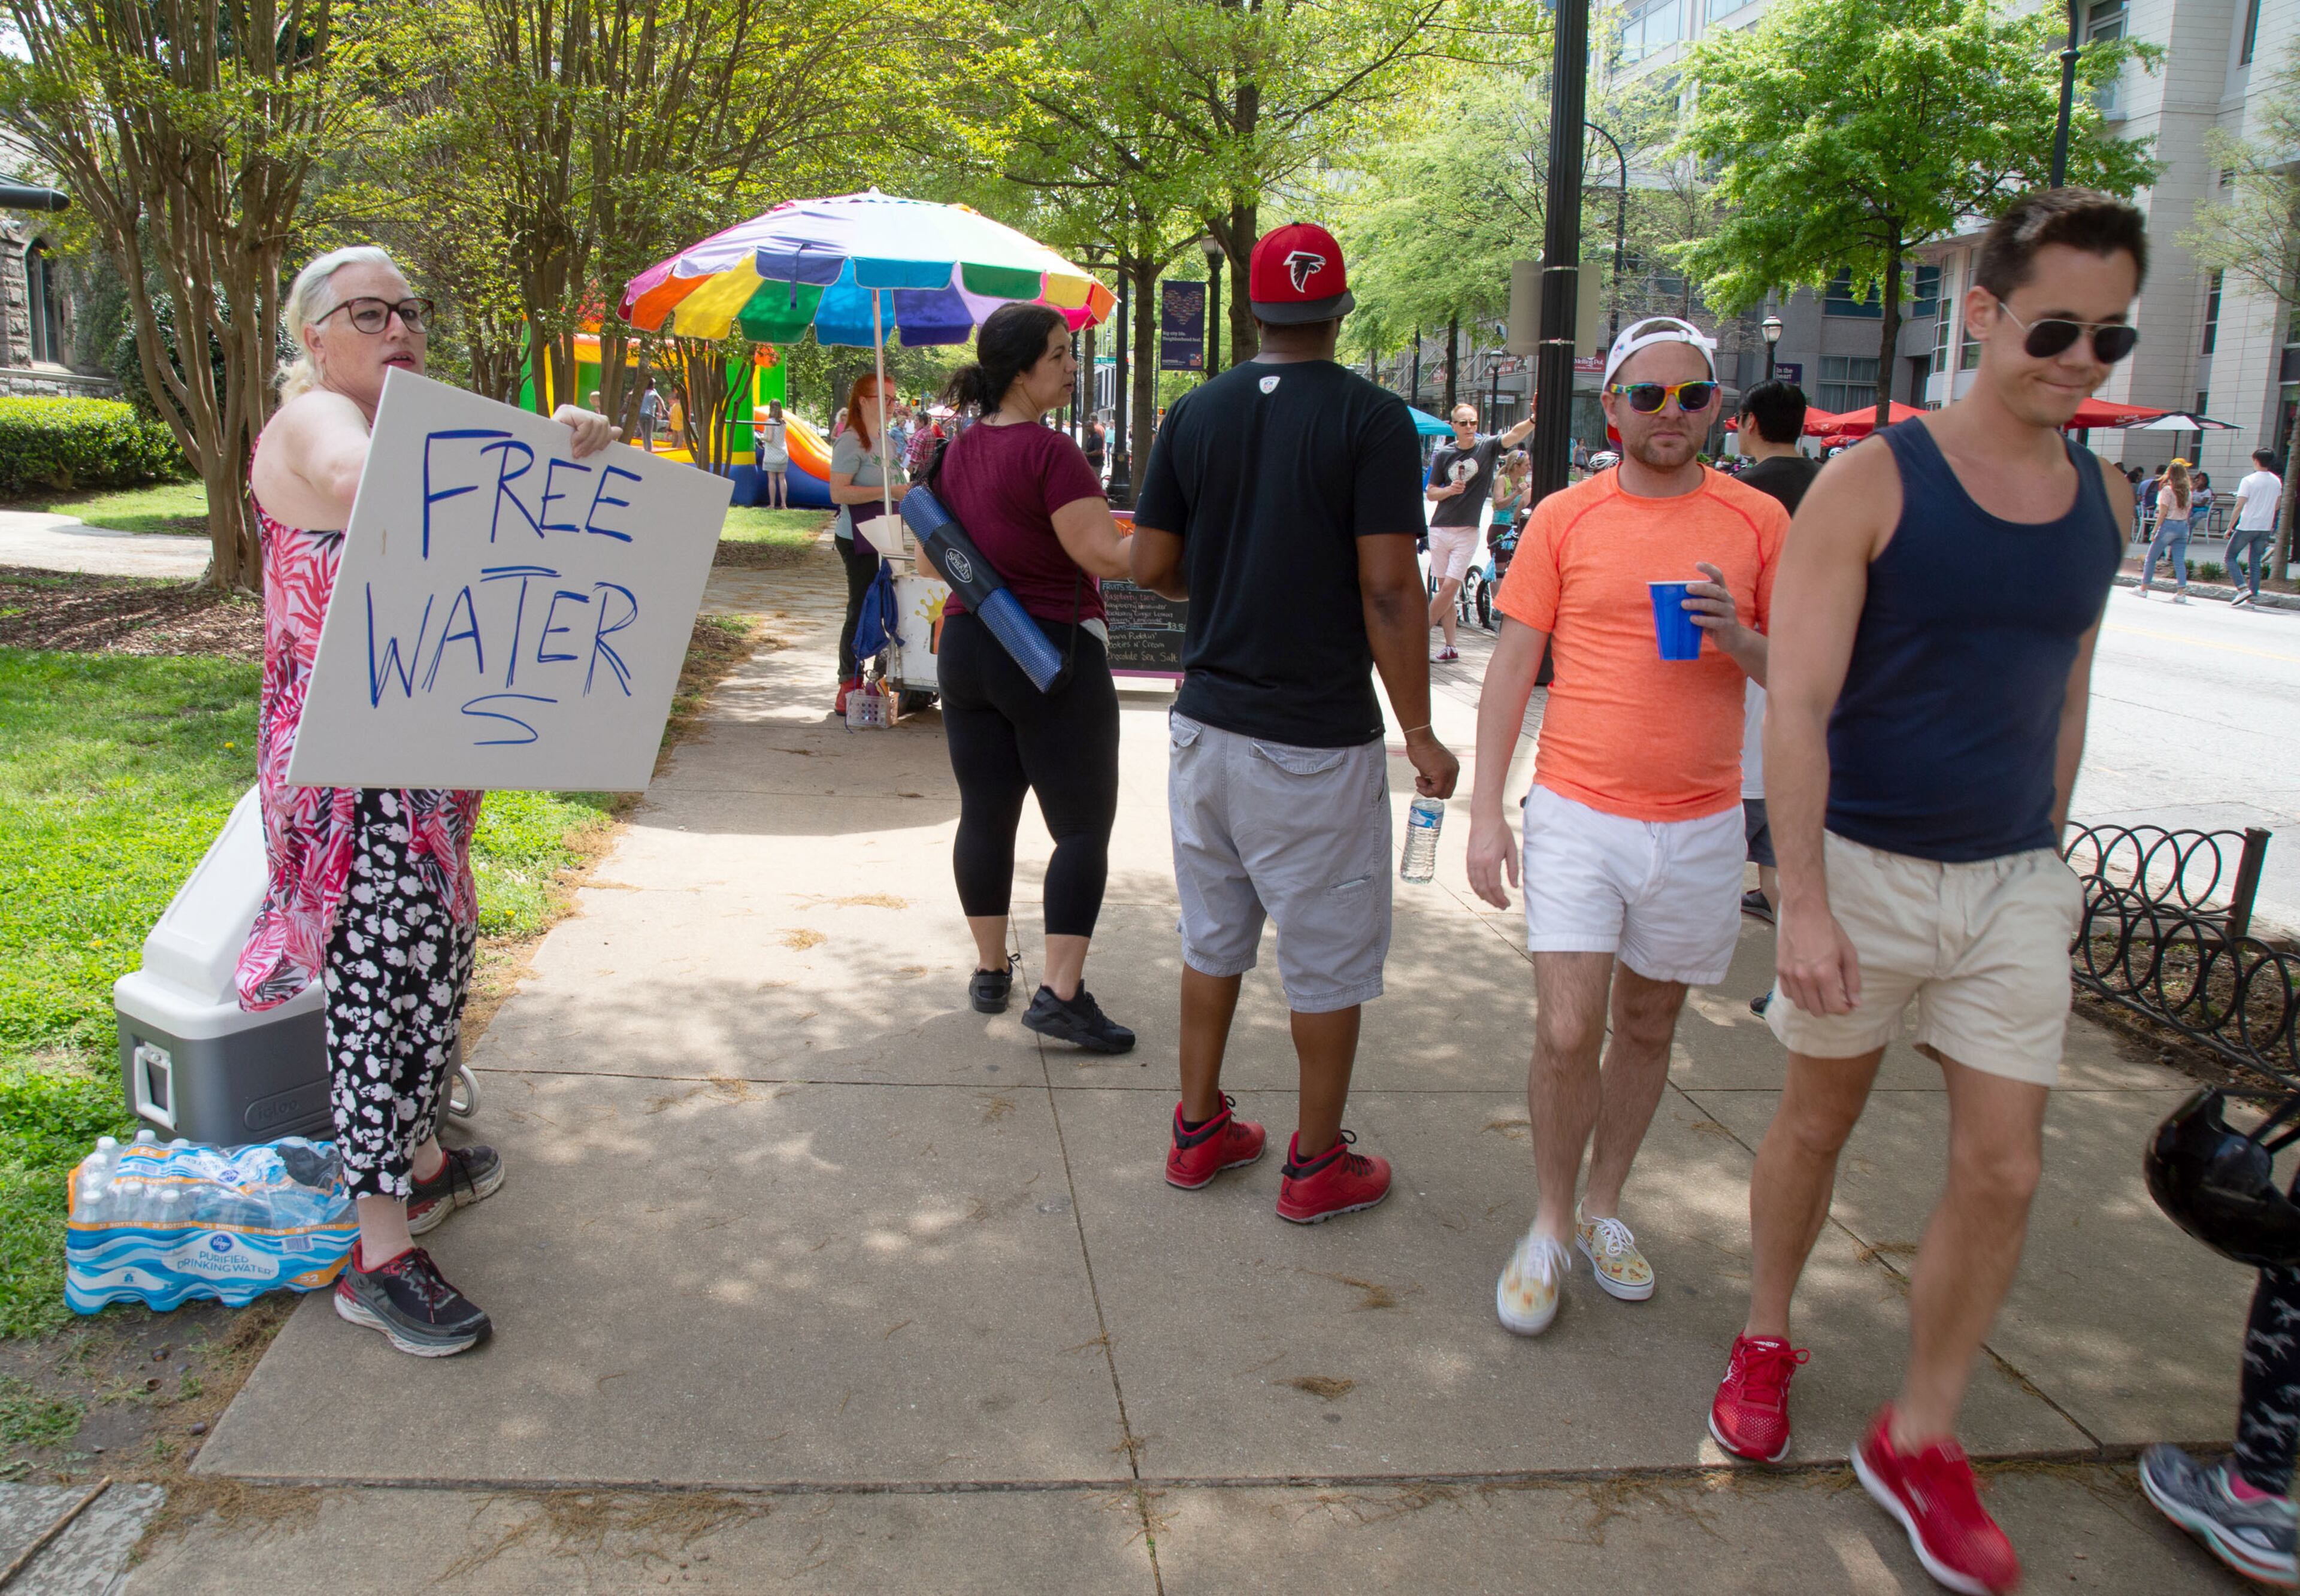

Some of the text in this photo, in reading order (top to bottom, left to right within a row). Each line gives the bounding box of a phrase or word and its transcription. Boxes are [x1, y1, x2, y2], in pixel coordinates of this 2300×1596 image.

[423, 429, 643, 560] FREE
[367, 566, 638, 709] WATER
[1142, 640, 1165, 649] Cream
[1140, 650, 1155, 662] Sea
[1160, 652, 1178, 663] Salt
[461, 693, 558, 745] S
[258, 1101, 298, 1122] igloo
[162, 1221, 192, 1229] BOTTLES
[199, 1250, 249, 1264] PURIFIED
[177, 1258, 273, 1275] DRINKING WATER
